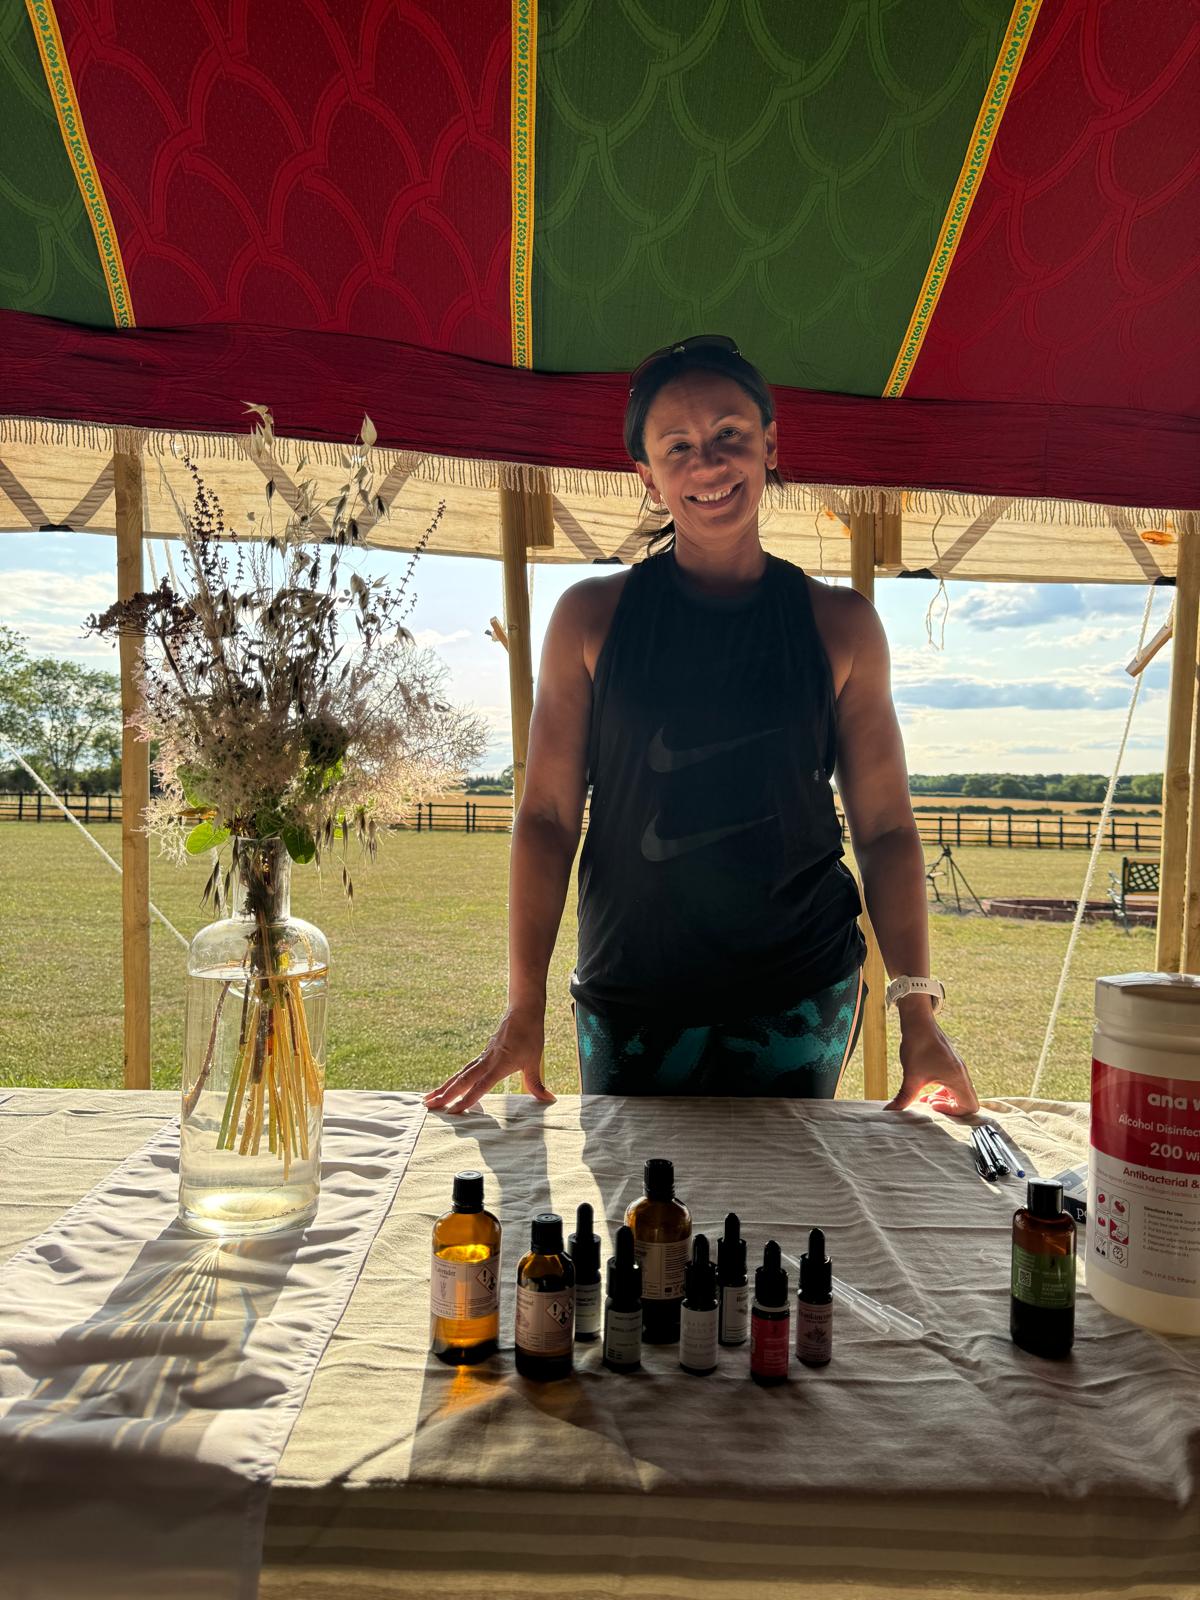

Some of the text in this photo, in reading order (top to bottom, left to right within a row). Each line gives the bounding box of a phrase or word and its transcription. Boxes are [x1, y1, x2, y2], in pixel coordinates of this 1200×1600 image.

[1147, 1093, 1188, 1110] ana
[1119, 1113, 1154, 1131] Alcohol
[1150, 1142, 1183, 1160] 200
[1123, 1167, 1188, 1187] Antibacterial
[1191, 1179, 1200, 1188] &
